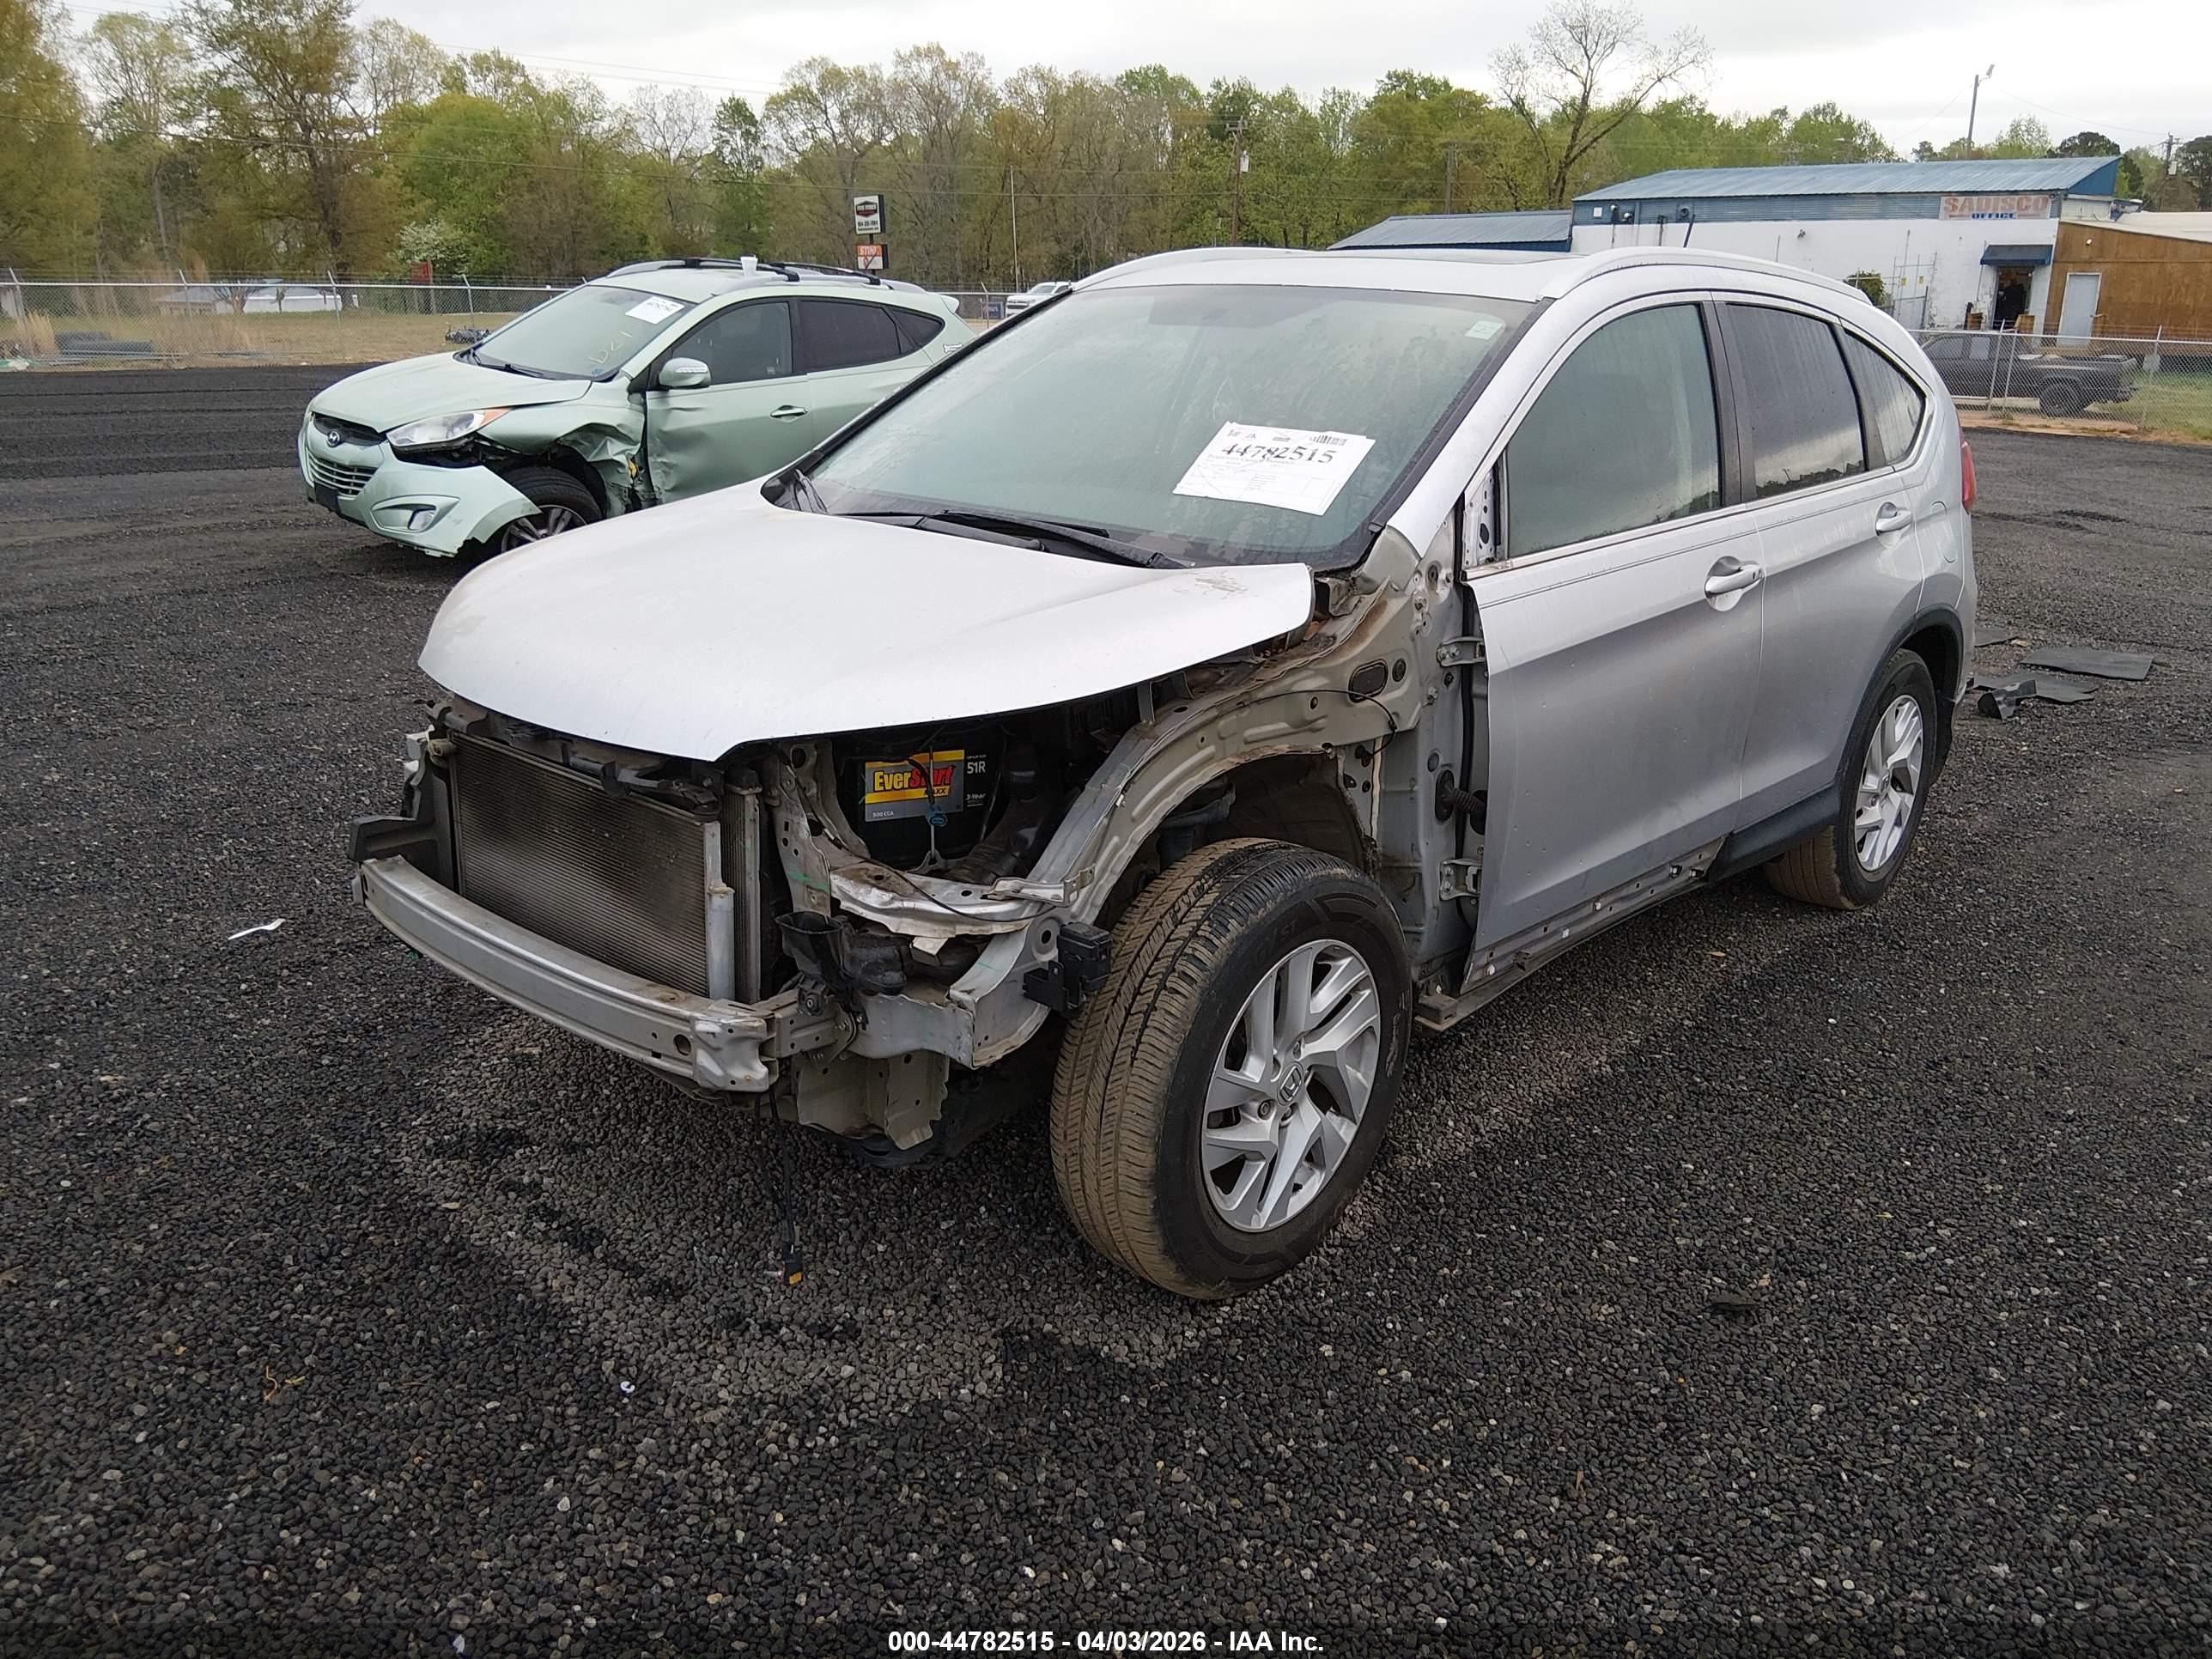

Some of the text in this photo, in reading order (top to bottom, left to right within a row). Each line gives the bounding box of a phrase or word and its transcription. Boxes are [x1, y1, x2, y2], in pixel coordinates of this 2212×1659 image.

[1943, 197, 2048, 212] SADISCO
[1221, 442, 1338, 464] 44782515
[967, 761, 986, 774] 51R
